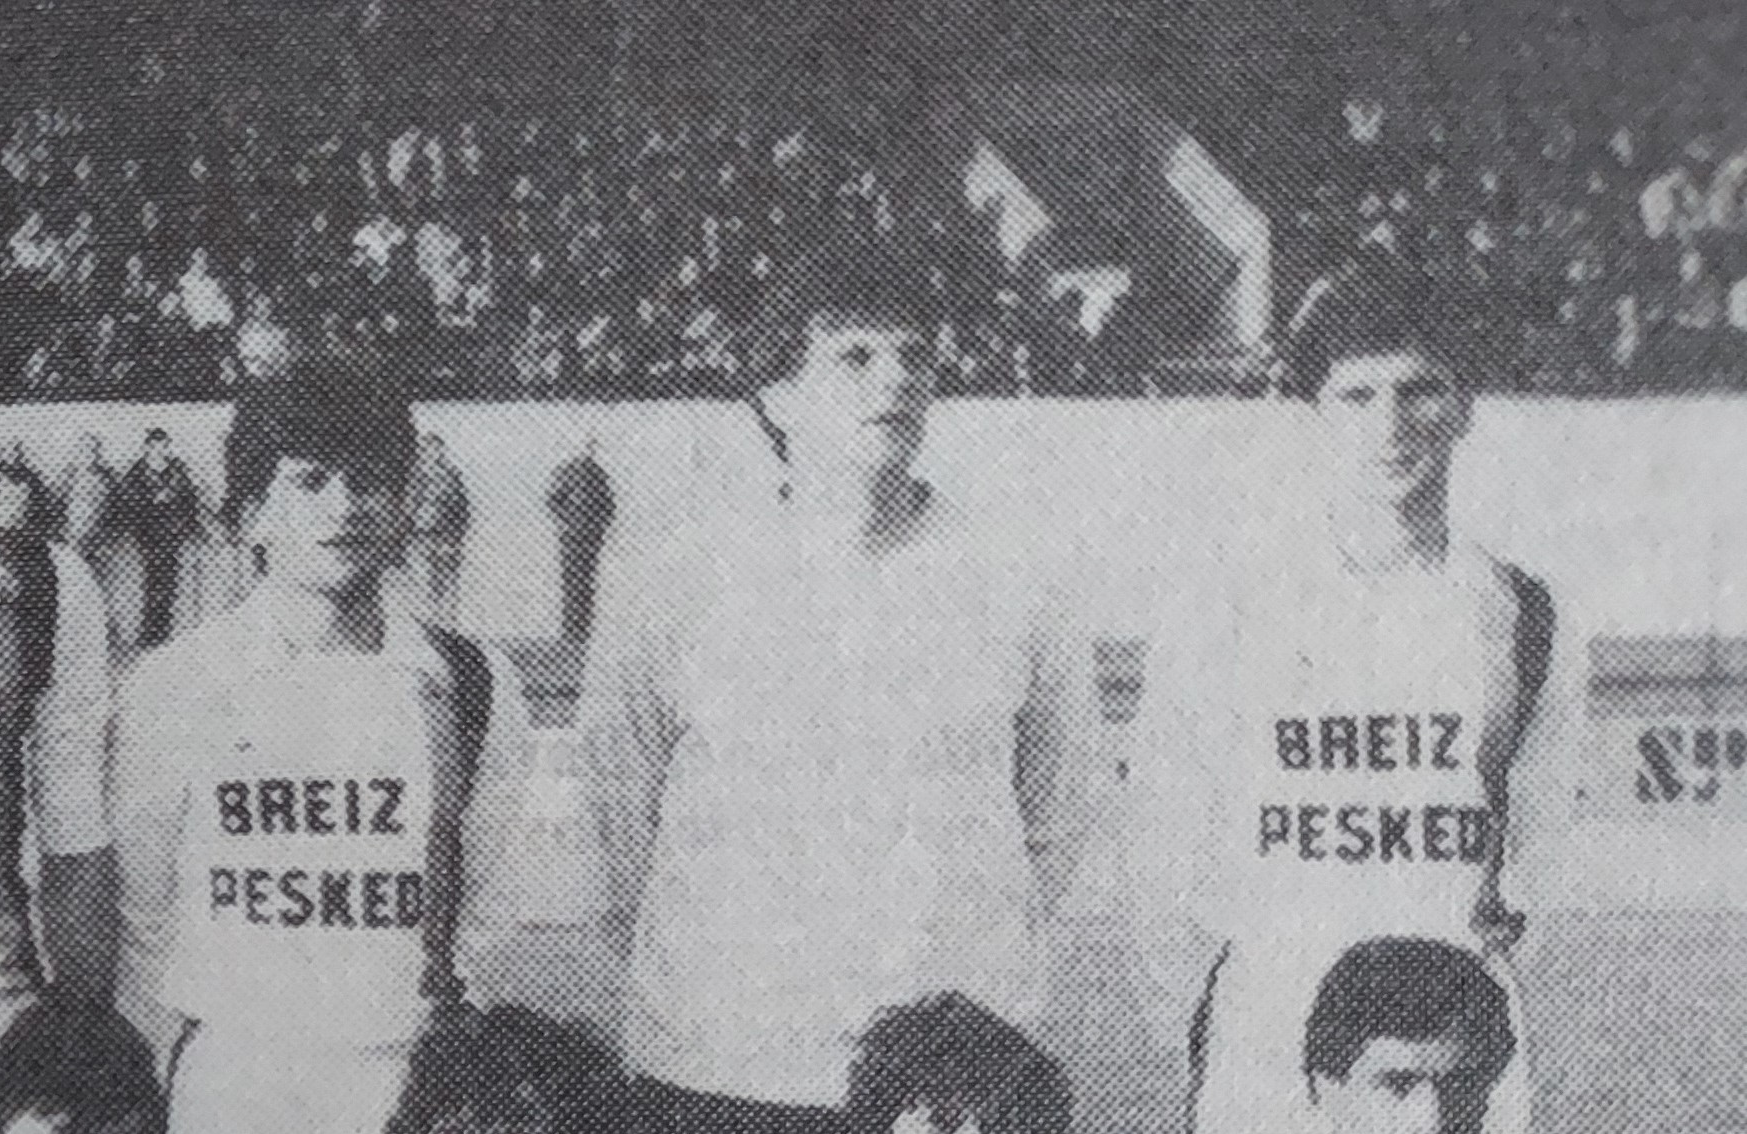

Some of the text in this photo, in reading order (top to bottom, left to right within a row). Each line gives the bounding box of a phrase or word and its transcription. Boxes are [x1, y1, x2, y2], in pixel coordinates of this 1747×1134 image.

[1276, 713, 1463, 771] BREIZ
[215, 778, 405, 835] BREIZ
[1259, 803, 1491, 864] PESKED
[209, 867, 424, 929] PESKED
